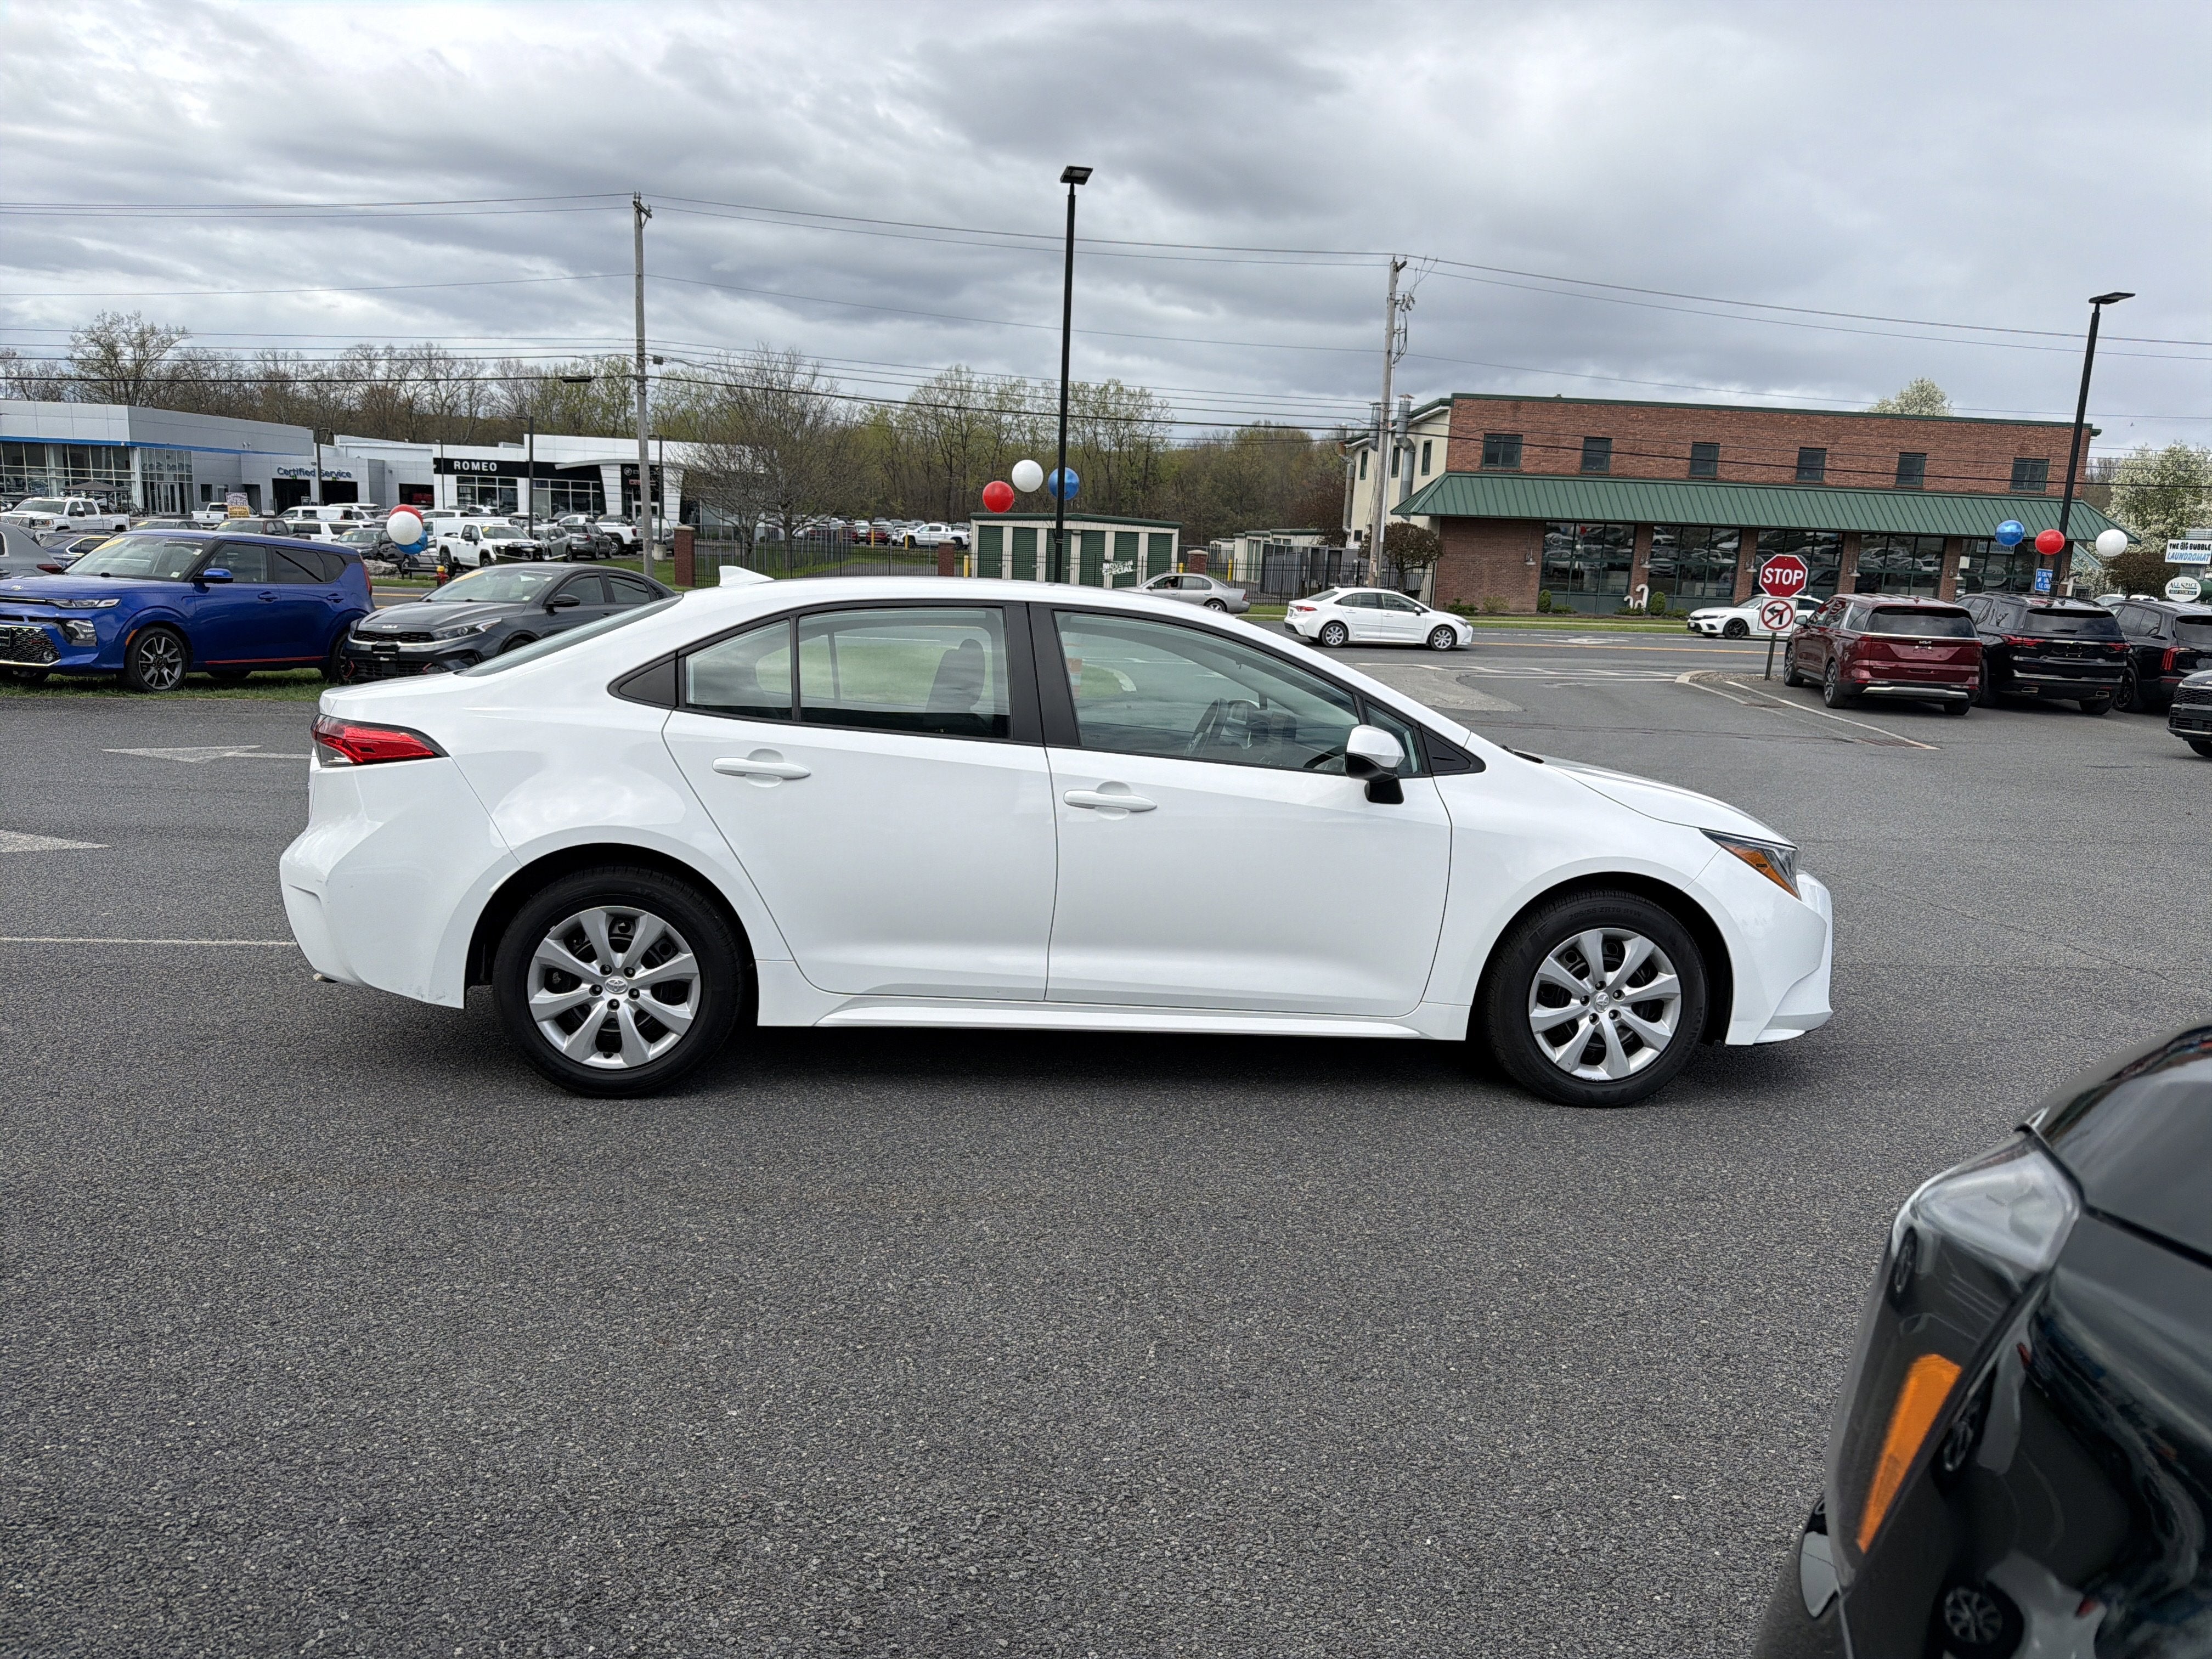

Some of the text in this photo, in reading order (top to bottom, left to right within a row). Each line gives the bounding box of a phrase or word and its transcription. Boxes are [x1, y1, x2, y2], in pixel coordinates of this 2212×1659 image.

[454, 461, 497, 471] ROMEO
[277, 467, 352, 478] Certified Service
[2180, 541, 2188, 551] BIG
[2167, 552, 2210, 561] LAUNDROMAT
[1103, 560, 1133, 569] MOVE-IN
[1102, 566, 1133, 575] SPECIAL
[1763, 568, 1803, 585] STOP
